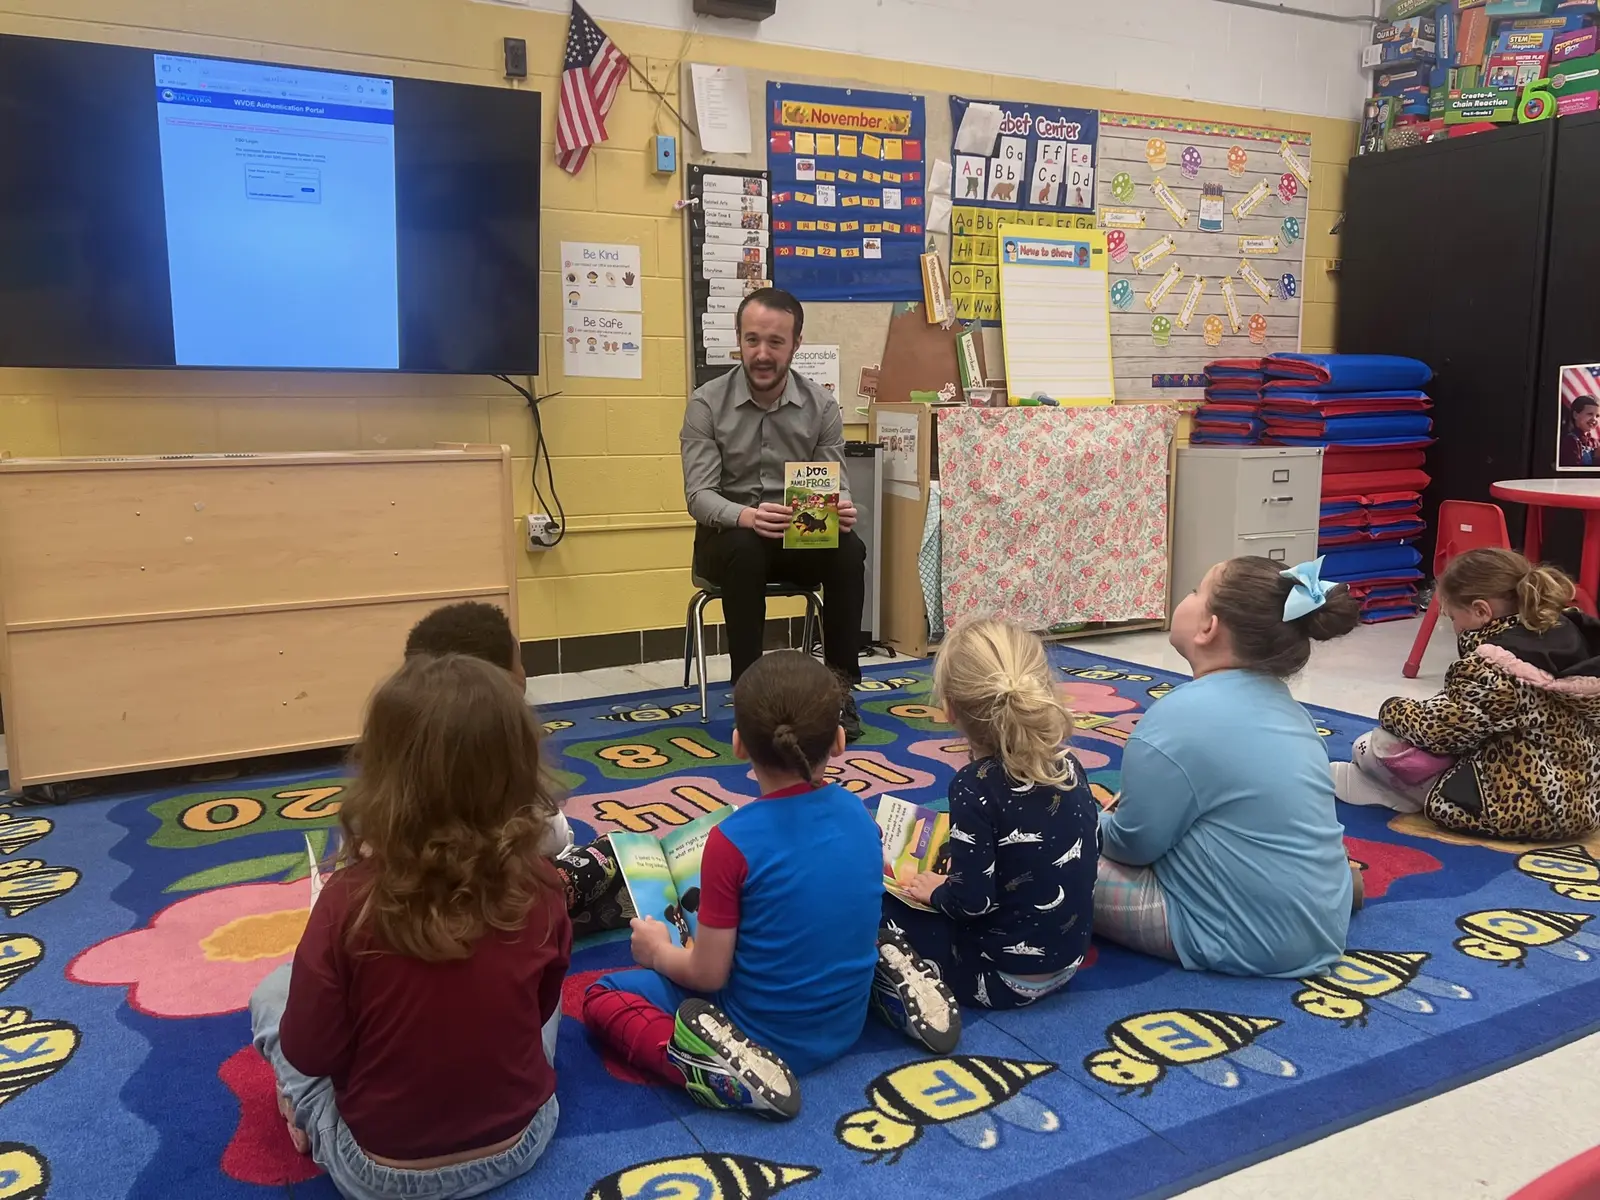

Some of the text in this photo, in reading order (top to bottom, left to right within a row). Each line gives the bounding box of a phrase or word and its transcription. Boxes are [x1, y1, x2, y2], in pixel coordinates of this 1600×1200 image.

[1376, 28, 1399, 39] QUAKE
[1509, 35, 1528, 43] STEM
[1564, 43, 1580, 55] BOX
[1452, 98, 1508, 108] Chain Reaction
[1461, 91, 1496, 100] Create-A-
[233, 99, 325, 114] WVDE Authentication Portal
[811, 107, 883, 129] November
[1037, 116, 1080, 138] Center
[1005, 145, 1014, 160] G
[1043, 144, 1063, 161] F f
[1071, 148, 1089, 164] E e
[843, 172, 850, 180] 2
[869, 173, 874, 181] 3
[889, 173, 894, 181] 4
[962, 161, 983, 177] A a
[995, 164, 1015, 181] B b
[1038, 167, 1057, 183] C c
[1072, 171, 1090, 187] D d
[802, 194, 807, 202] 7
[848, 197, 853, 205] 9
[910, 198, 917, 206] 12
[802, 222, 810, 230] 14
[823, 222, 830, 230] 15
[846, 222, 853, 230] 16
[869, 224, 876, 232] 17
[888, 223, 895, 231] 18
[910, 225, 917, 233] 19
[583, 248, 619, 261] Be Kind
[779, 247, 855, 257] 20 21 22 23
[1019, 244, 1074, 260] News to Share
[583, 316, 623, 330] Be Safe
[881, 426, 912, 434] Discovery Center
[796, 466, 828, 478] A DOG
[790, 478, 831, 488] NAMED FROG
[594, 736, 721, 770] 18
[176, 785, 346, 833] 20
[594, 784, 738, 833] 14
[675, 843, 685, 852] was
[687, 845, 696, 854] my
[1533, 858, 1583, 873] B
[1488, 916, 1539, 936] C
[1331, 960, 1390, 985] D
[1142, 1019, 1207, 1051] E
[919, 1069, 976, 1105] F
